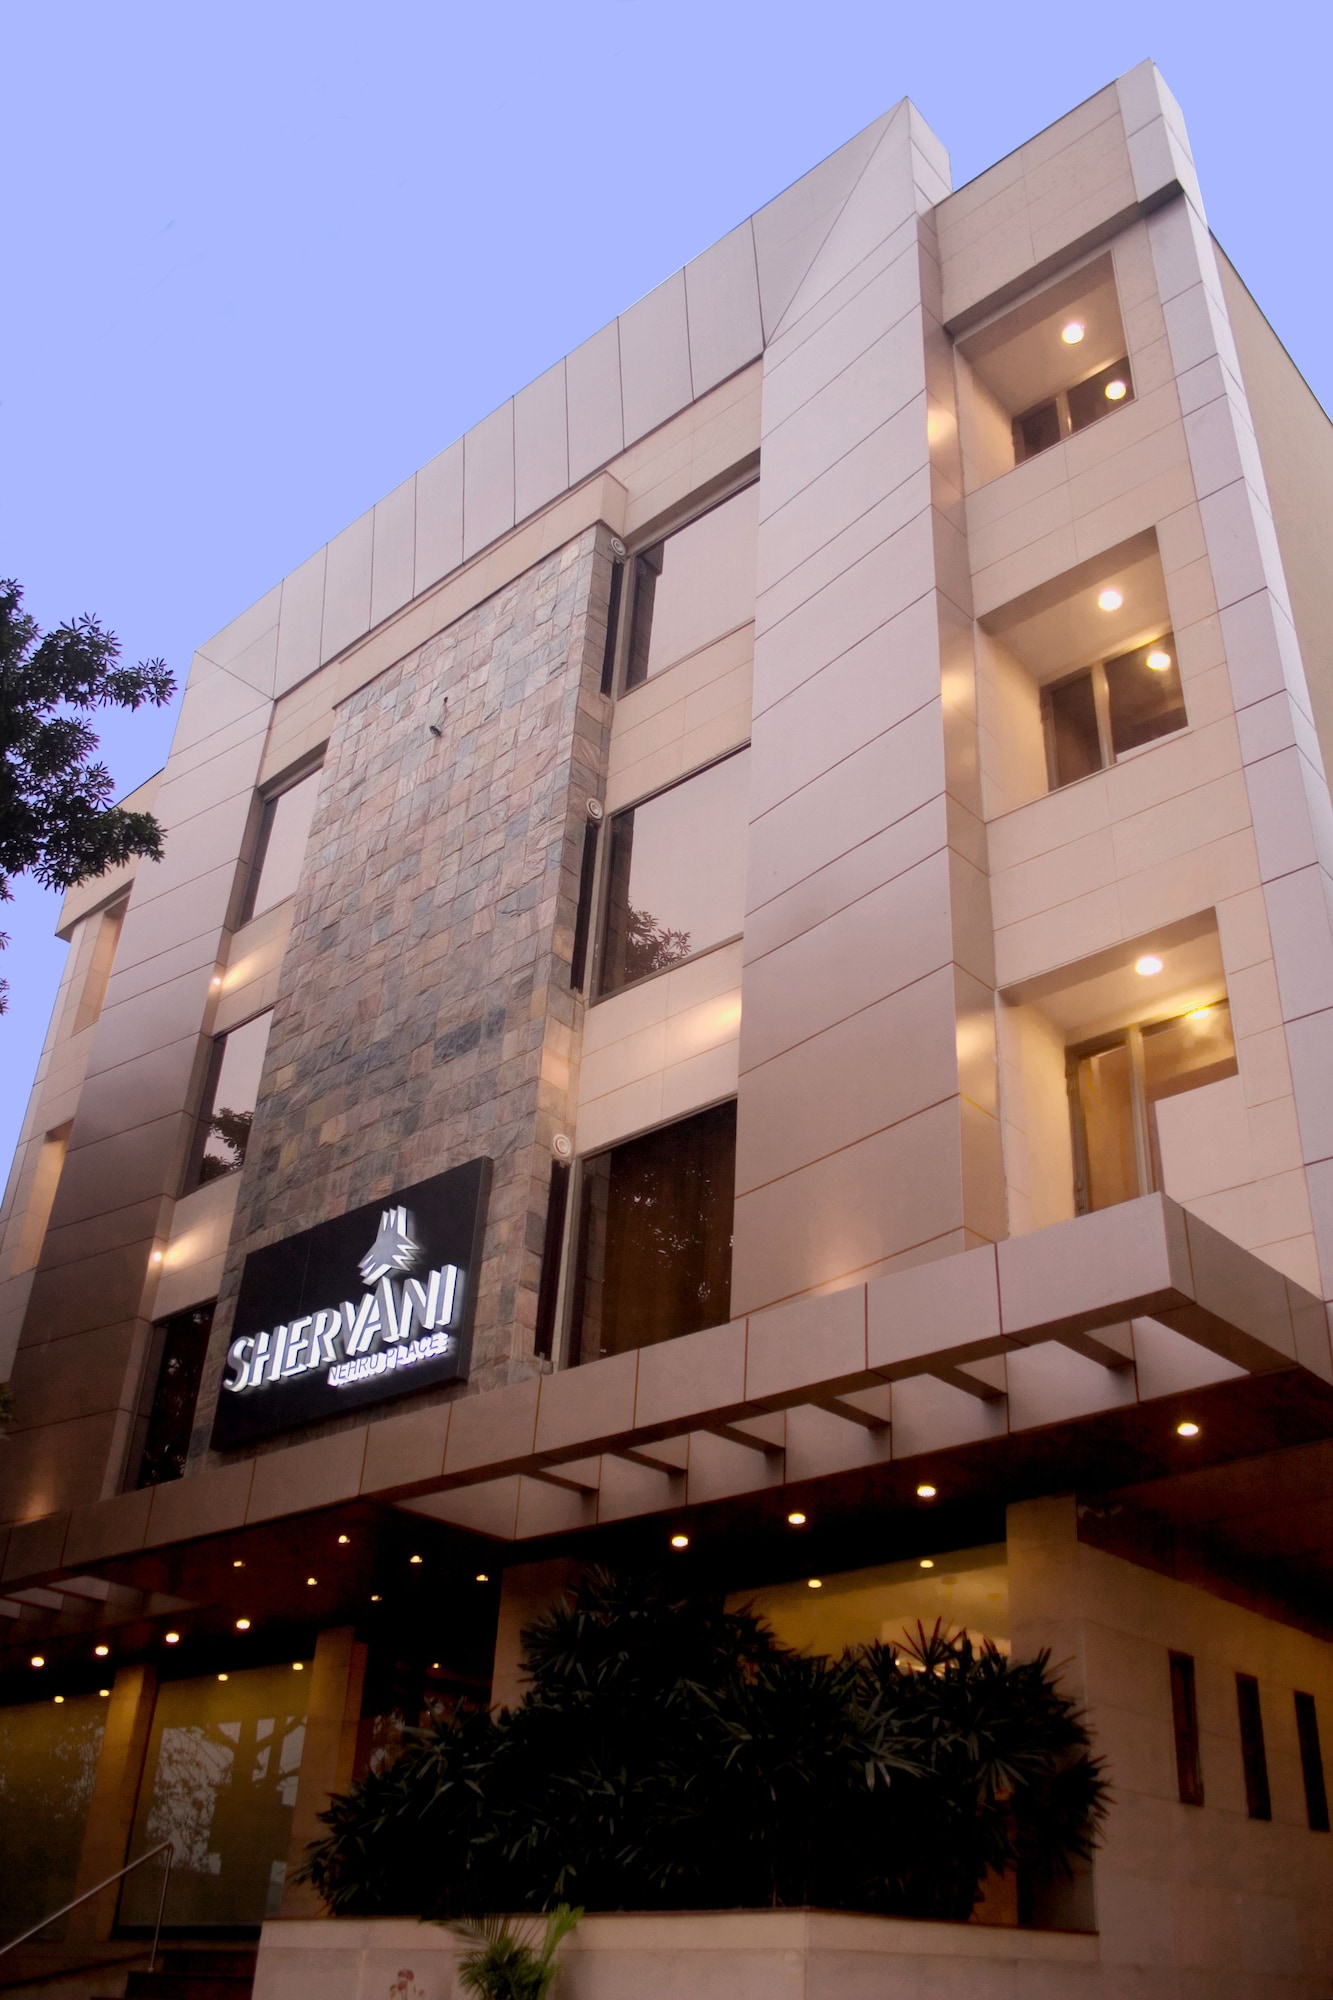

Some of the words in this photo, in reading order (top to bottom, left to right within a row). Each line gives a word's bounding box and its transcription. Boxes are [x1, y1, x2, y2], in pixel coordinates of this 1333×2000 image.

[223, 1264, 457, 1392] SHERVANI
[327, 1352, 387, 1387] NEHRU
[386, 1331, 449, 1369] PLACE
